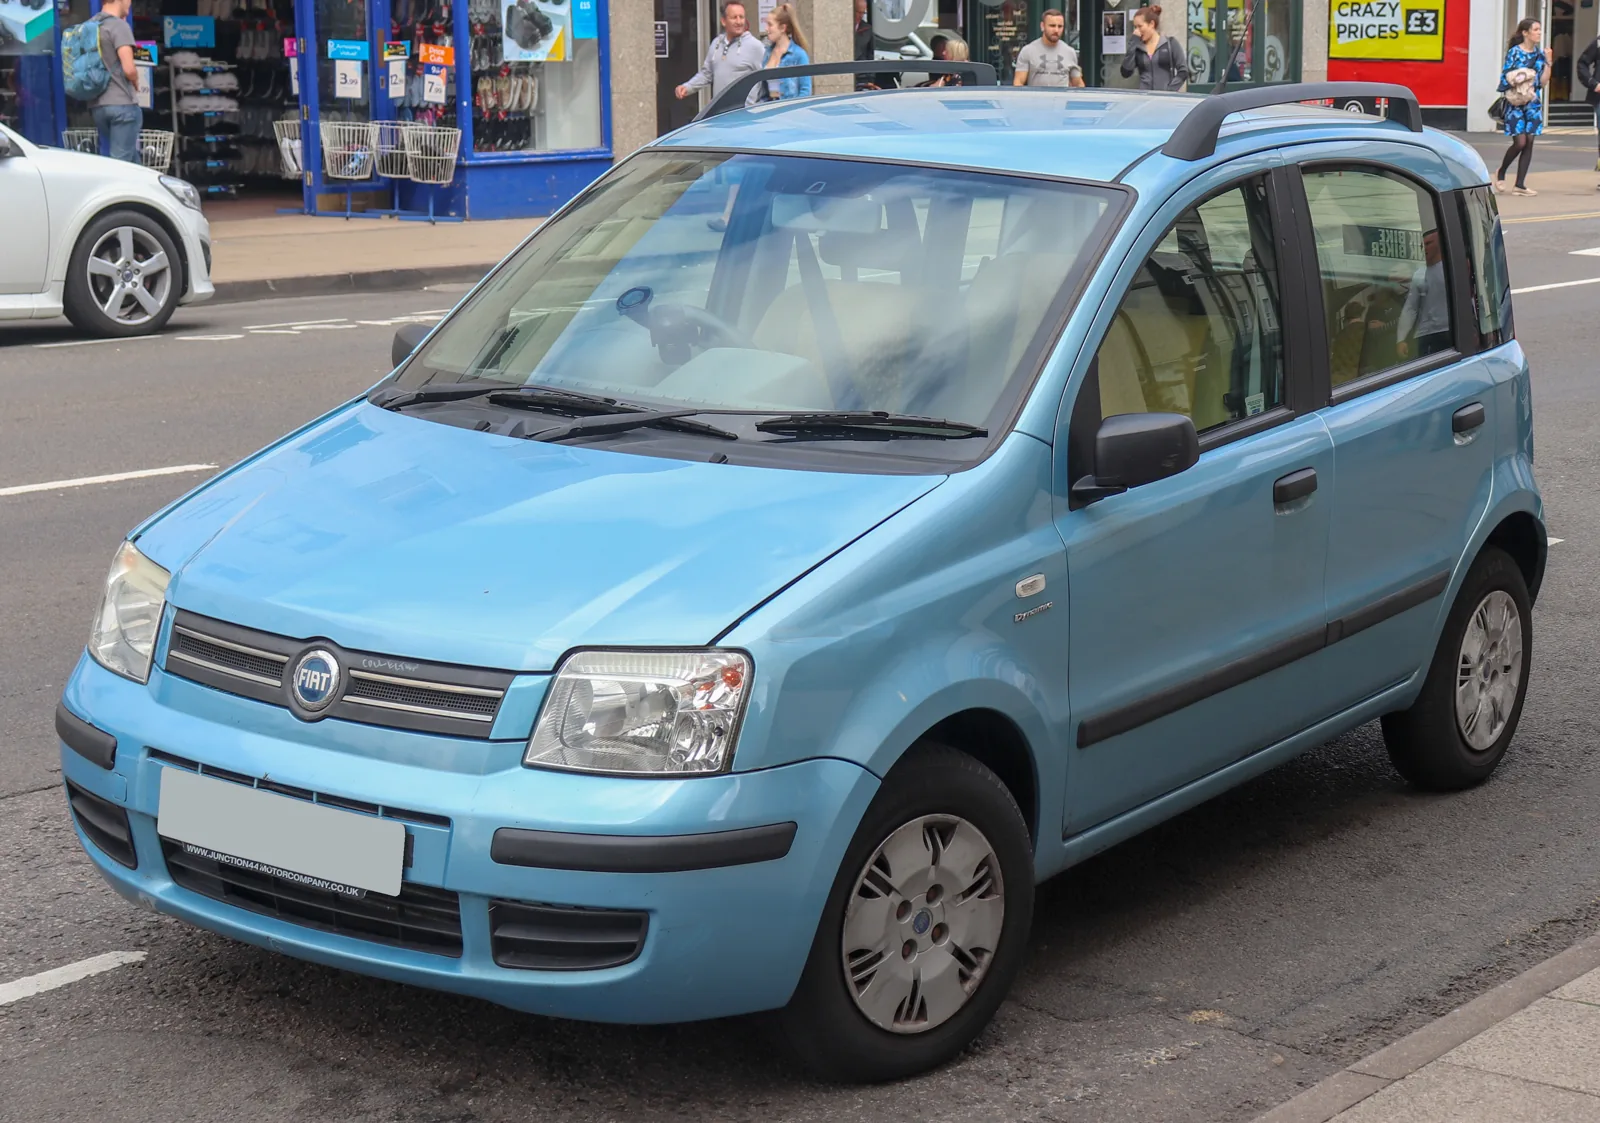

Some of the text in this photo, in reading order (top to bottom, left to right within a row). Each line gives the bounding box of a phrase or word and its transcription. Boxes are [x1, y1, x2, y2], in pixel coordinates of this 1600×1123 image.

[1337, 2, 1400, 17] CRAZY
[176, 22, 203, 33] Amazing
[1408, 12, 1436, 32] £3
[1336, 23, 1399, 39] PRICES
[336, 43, 361, 51] Amazing
[429, 46, 445, 56] Price
[429, 55, 444, 63] Cuts
[339, 72, 358, 86] 3.99
[1014, 601, 1053, 622] Dynamic
[298, 668, 330, 692] FIAT
